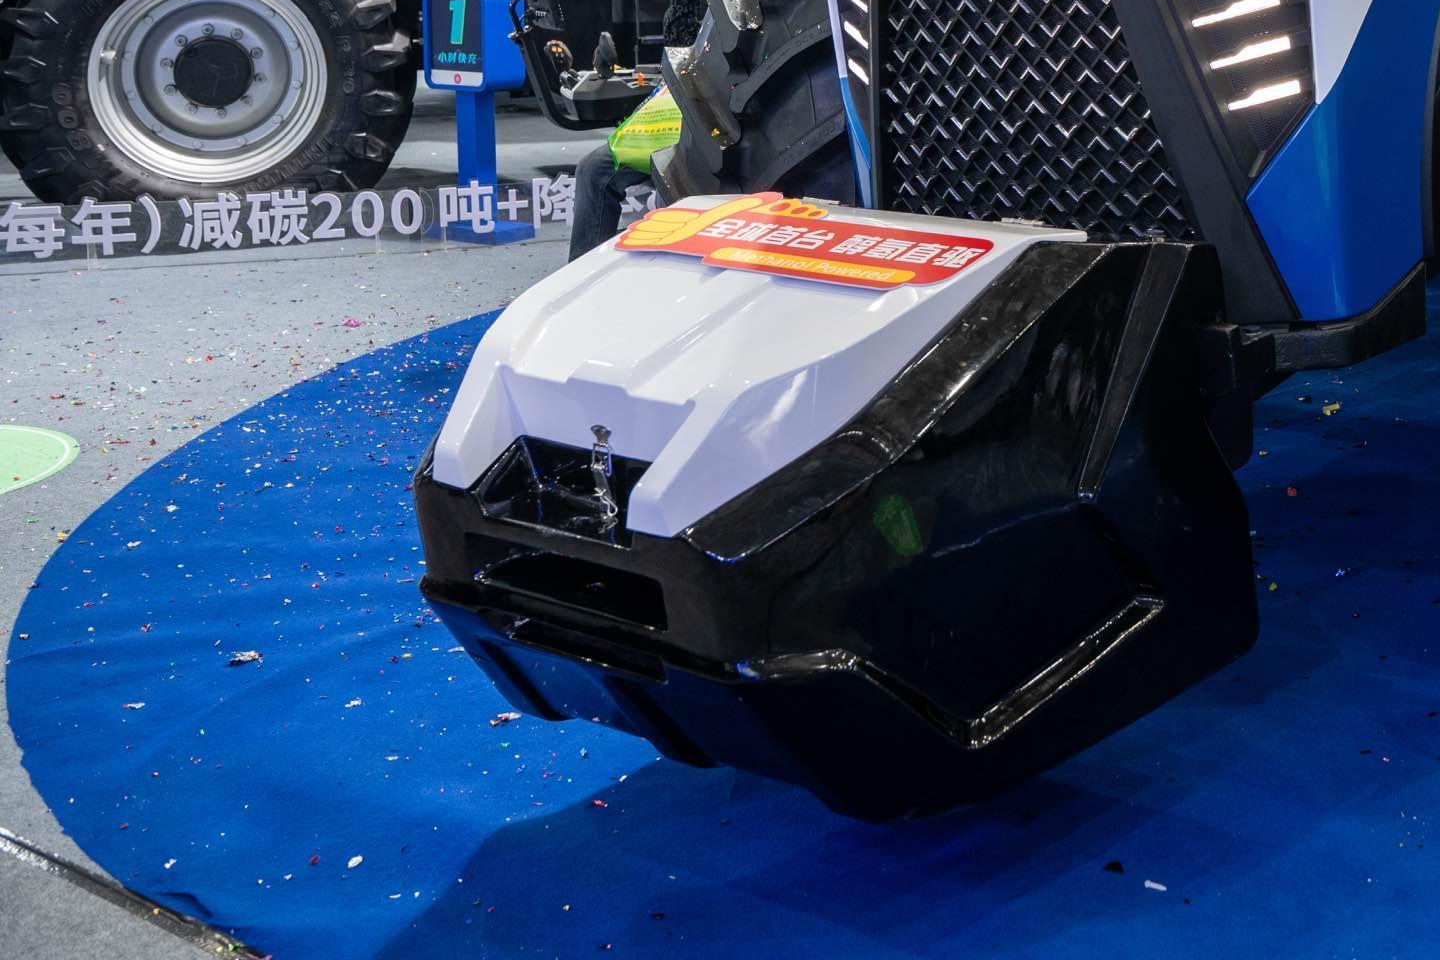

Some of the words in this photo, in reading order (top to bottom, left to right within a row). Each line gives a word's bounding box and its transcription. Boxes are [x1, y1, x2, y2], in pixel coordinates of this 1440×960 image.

[699, 218, 835, 252] 全球首台
[829, 233, 988, 270] 醇氢直驱
[818, 264, 898, 283] Powered
